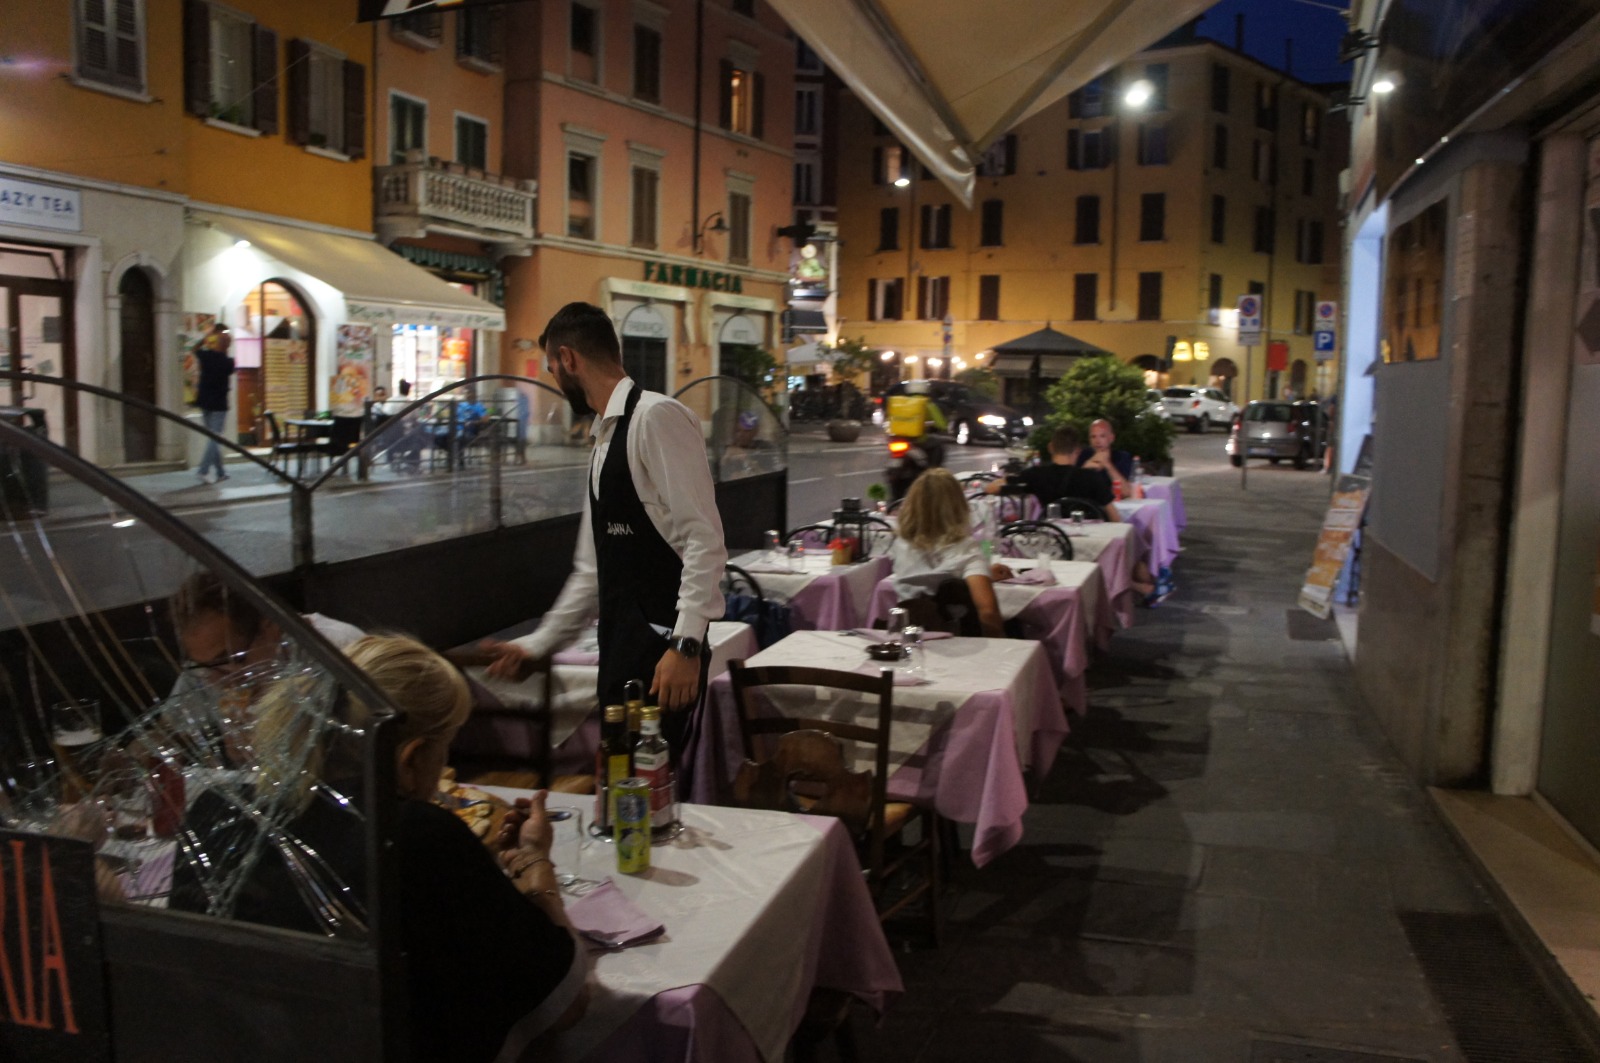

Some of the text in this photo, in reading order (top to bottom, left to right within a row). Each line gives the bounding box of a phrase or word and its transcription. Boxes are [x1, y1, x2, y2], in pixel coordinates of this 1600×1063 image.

[41, 196, 75, 213] TEA
[644, 261, 742, 294] FARMACIA
[1316, 333, 1332, 349] P
